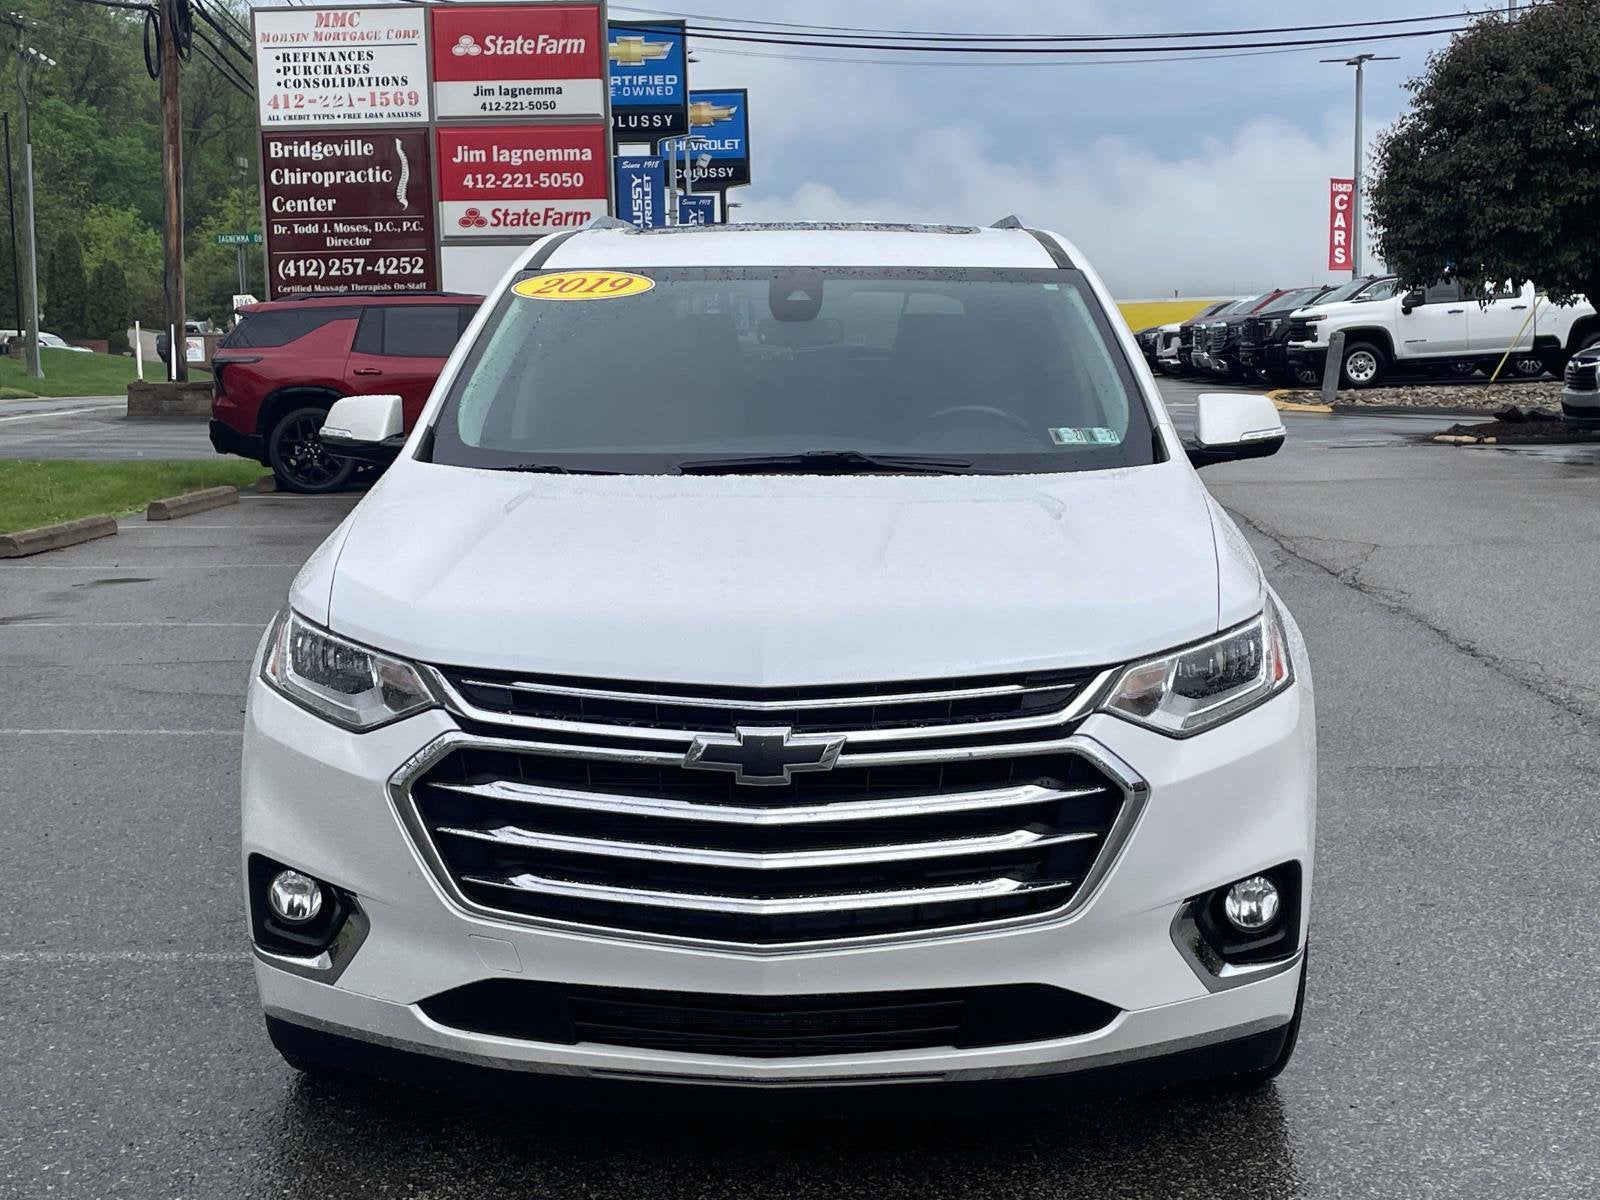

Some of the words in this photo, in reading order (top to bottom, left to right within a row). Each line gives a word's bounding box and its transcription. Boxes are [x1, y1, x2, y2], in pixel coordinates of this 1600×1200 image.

[315, 12, 361, 28] MMC
[260, 32, 309, 43] MOHSIN
[313, 30, 381, 42] MORTGAGE
[387, 29, 420, 39] CORP.
[282, 51, 374, 63] REFINANCES
[283, 64, 370, 76] PURCHASES
[284, 76, 408, 89] CONSOLIDATIONS
[473, 86, 495, 97] Jim
[267, 91, 419, 109] 412-221-1569
[481, 101, 556, 111] 412-221-5050
[270, 139, 374, 160] Bridgeville
[452, 146, 486, 163] Jim
[493, 145, 592, 165] Iagnemma
[270, 166, 392, 187] Chiropractic
[463, 172, 584, 189] 412-221-5050
[1332, 183, 1353, 192] USED
[272, 196, 336, 212] Center
[631, 174, 643, 228] USSY
[273, 225, 291, 234] Dr.
[293, 224, 319, 234] Todd
[322, 224, 331, 233] J.
[334, 223, 372, 233] Moses,
[403, 221, 423, 231] P.C.
[1334, 193, 1349, 264] CARS
[218, 234, 250, 244] IAGNEMMA
[326, 237, 372, 247] Director
[278, 284, 312, 292] Certified
[314, 284, 348, 293] Massage
[352, 283, 391, 293] Therapists
[394, 282, 427, 290] On-Staff
[532, 277, 634, 294] 2019
